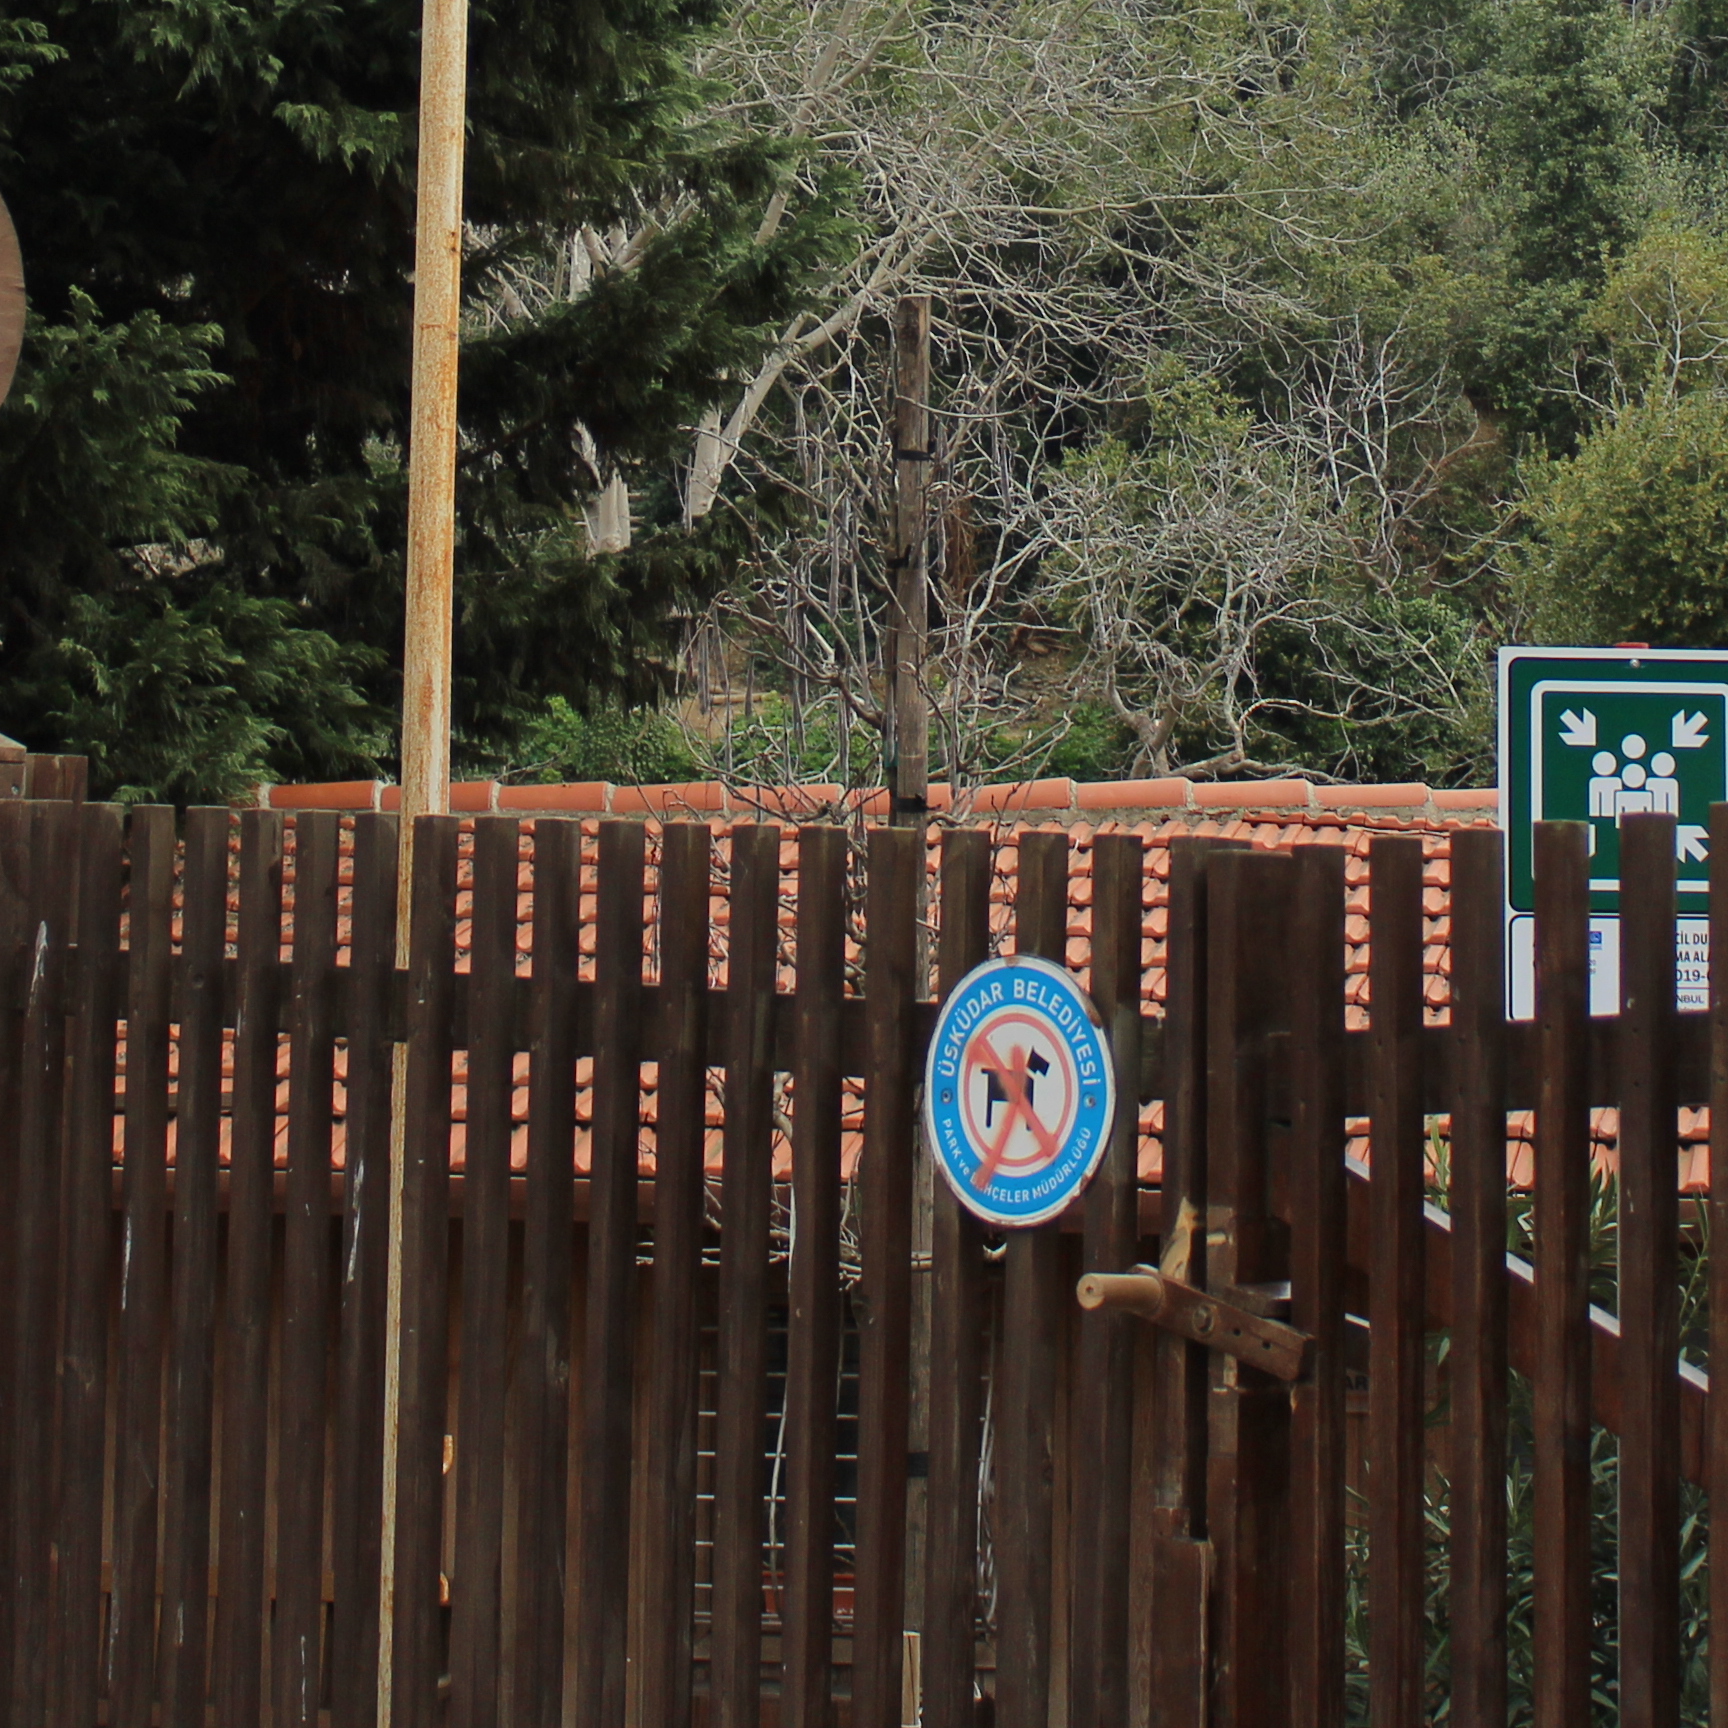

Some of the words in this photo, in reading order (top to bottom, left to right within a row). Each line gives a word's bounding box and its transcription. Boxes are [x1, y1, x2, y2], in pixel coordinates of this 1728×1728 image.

[937, 981, 1004, 1077] ÜSKÜDAR
[1013, 978, 1101, 1086] BELEDİYESİ
[1675, 994, 1704, 1004] NBUL
[942, 1118, 962, 1160] PARK
[959, 1159, 970, 1176] ve
[969, 1172, 1030, 1203] HÇELER
[1032, 1126, 1092, 1198] MÜDÜRLÜĞÜ
